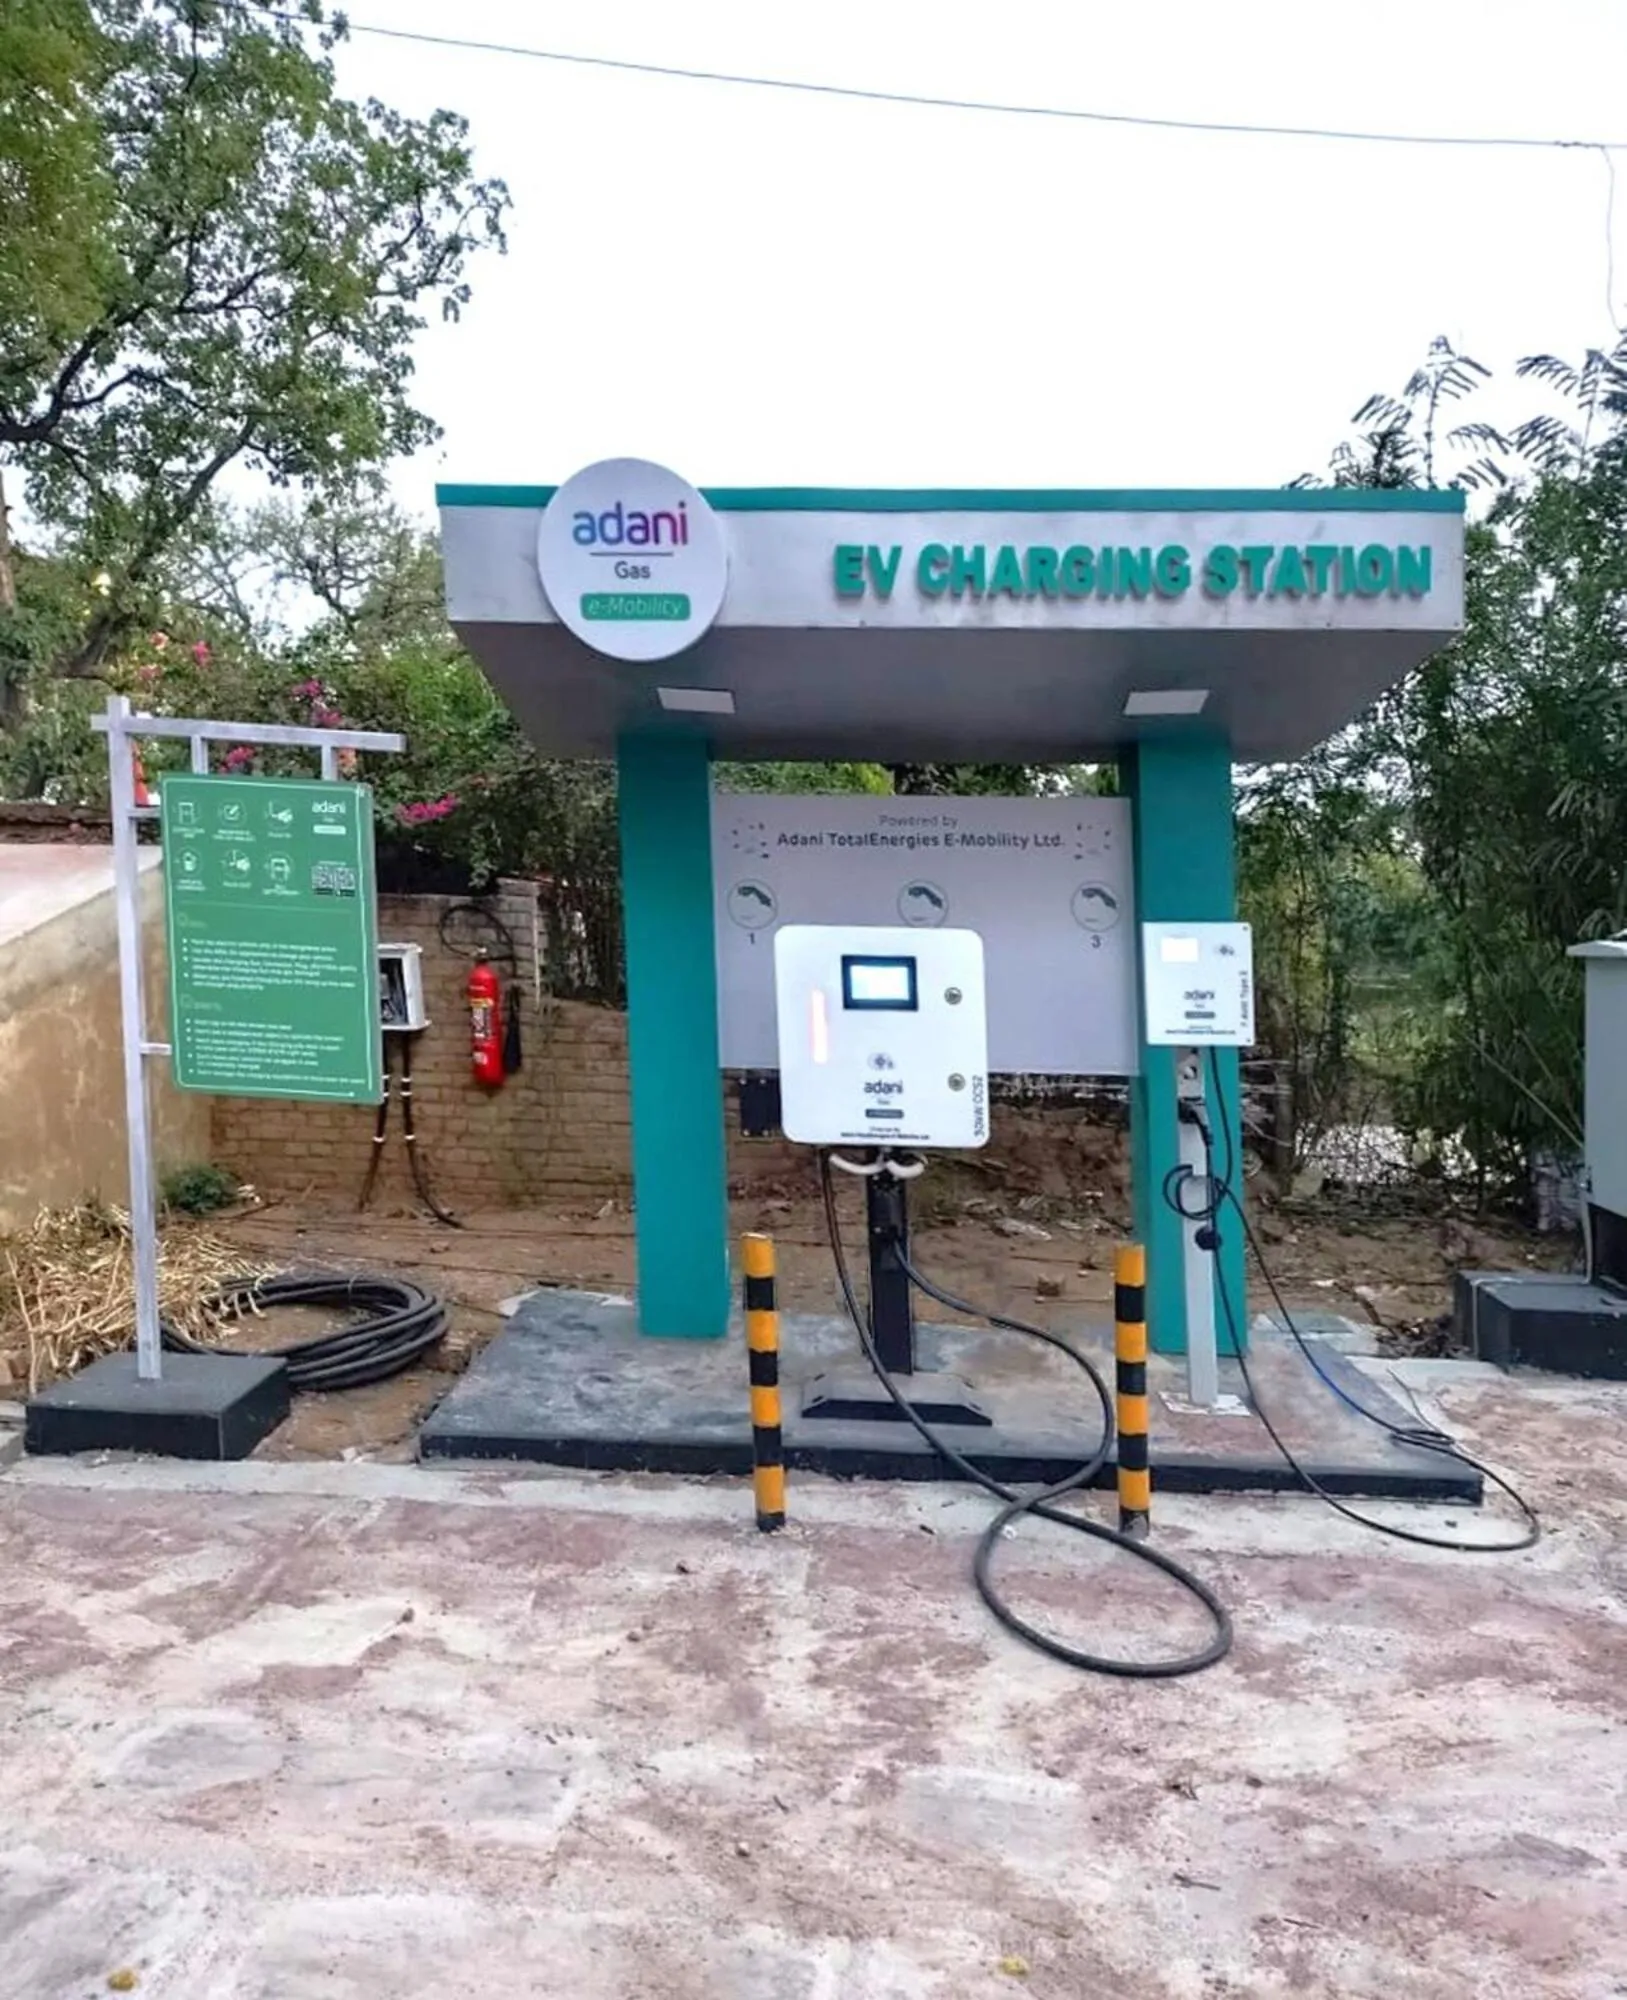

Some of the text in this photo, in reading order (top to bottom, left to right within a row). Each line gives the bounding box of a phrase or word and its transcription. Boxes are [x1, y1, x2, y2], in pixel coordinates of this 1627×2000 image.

[572, 500, 688, 545] adani
[614, 560, 651, 579] Gas
[833, 543, 1433, 598] EV CHARGING STATION
[588, 596, 682, 617] e-Mobility
[878, 814, 958, 829] Powered by
[777, 832, 1066, 850] Adani TotalEnergies E-Mobility Ltd.
[748, 933, 757, 945] 1
[1091, 935, 1102, 949] 3
[864, 1079, 903, 1095] adani
